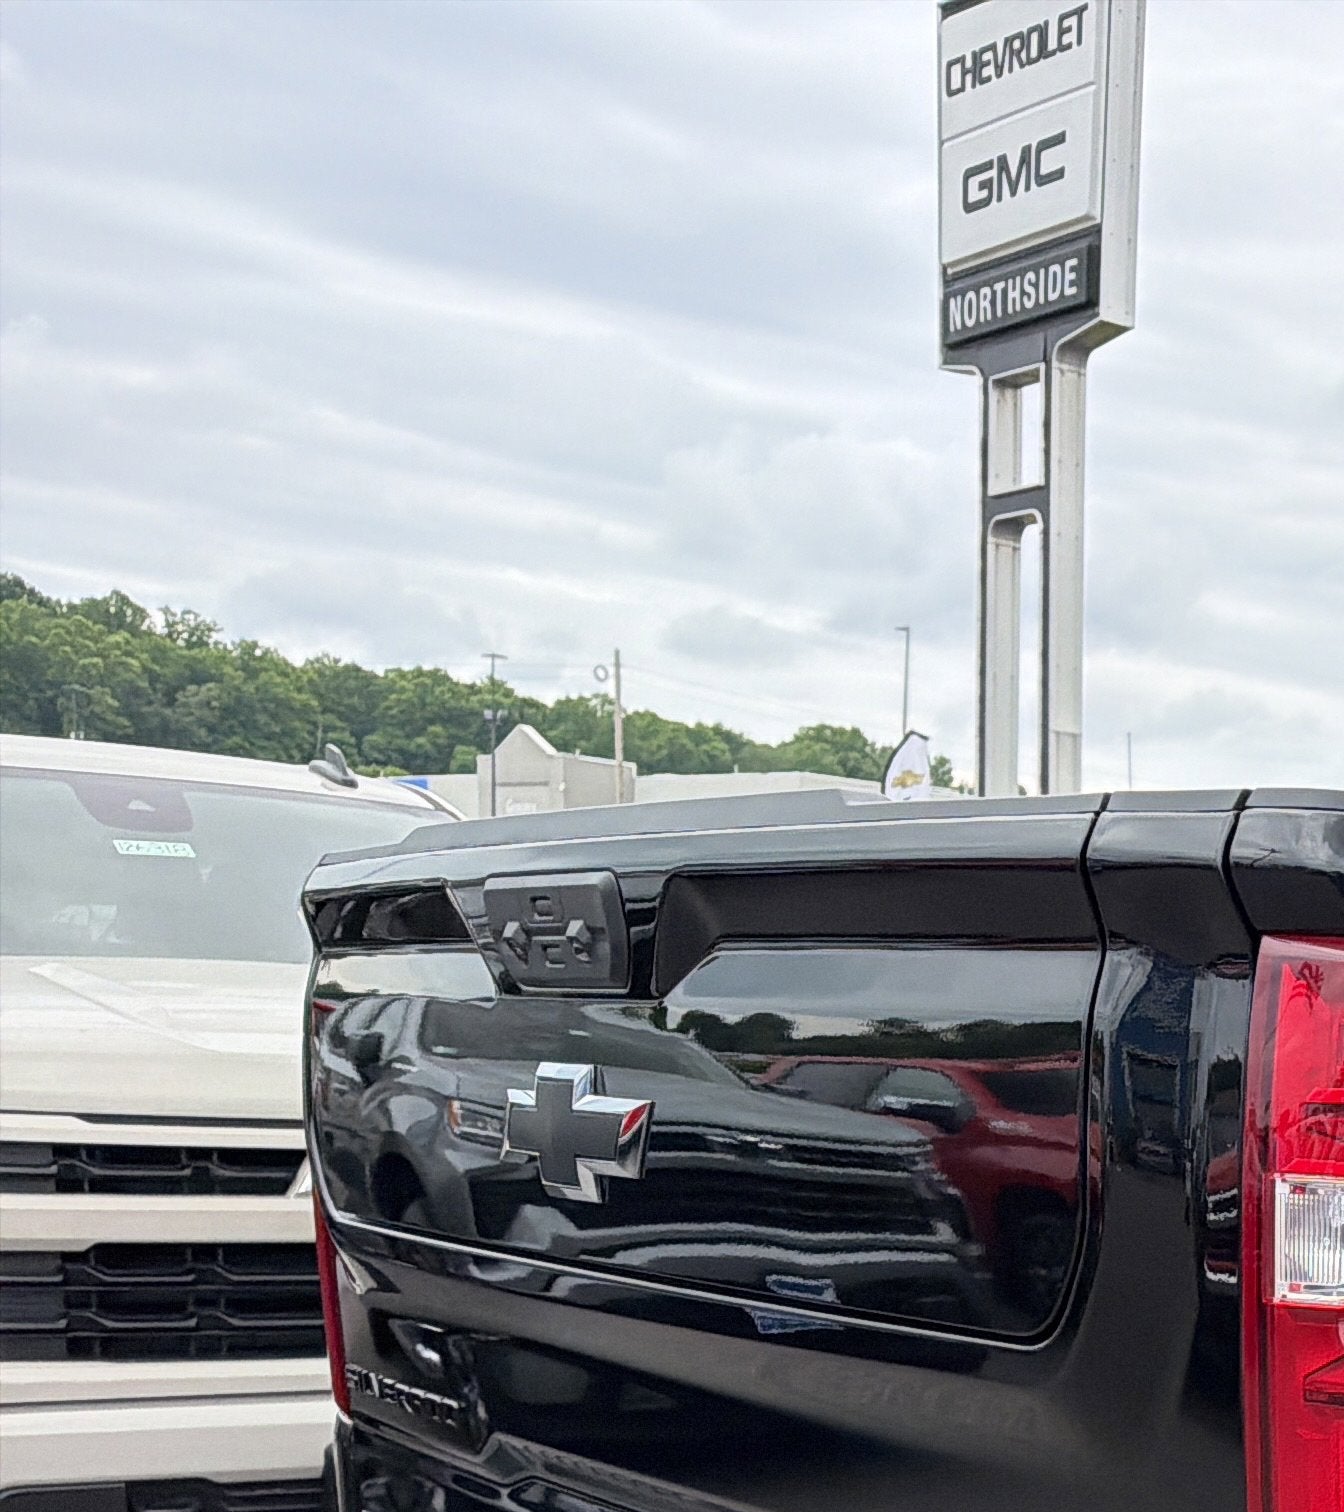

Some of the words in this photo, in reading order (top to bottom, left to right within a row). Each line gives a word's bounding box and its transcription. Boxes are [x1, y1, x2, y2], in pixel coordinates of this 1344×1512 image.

[945, 2, 1089, 98] CHEVROLET
[962, 130, 1067, 214] GMC
[949, 257, 1079, 333] NORTHSIDE
